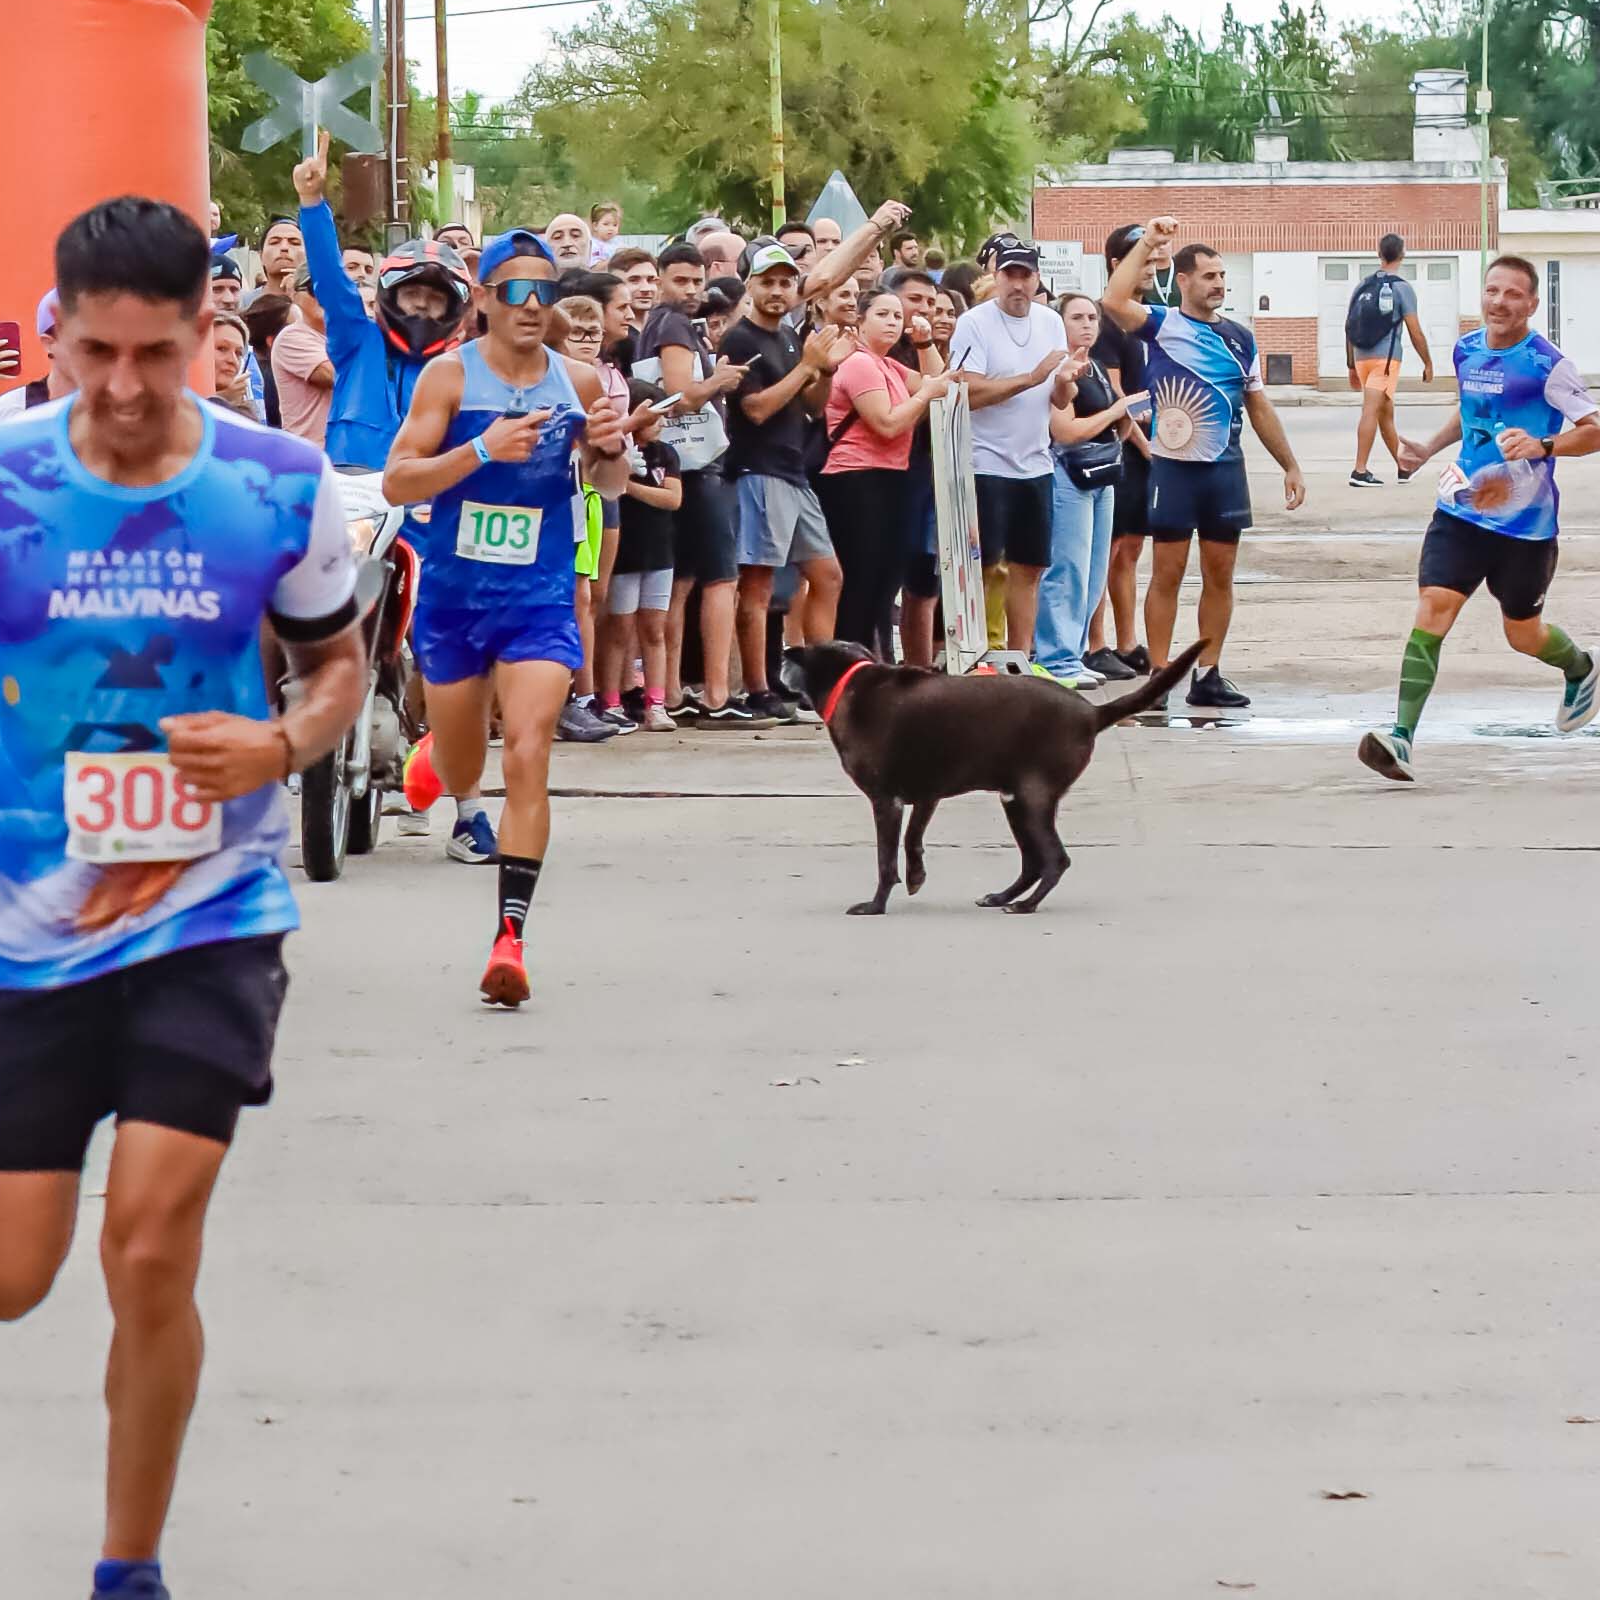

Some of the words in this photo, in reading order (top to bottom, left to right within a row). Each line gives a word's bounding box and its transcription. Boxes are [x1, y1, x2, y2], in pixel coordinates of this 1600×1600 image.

[469, 510, 531, 549] 103
[48, 587, 221, 621] MALVINAS
[76, 764, 213, 833] 308
